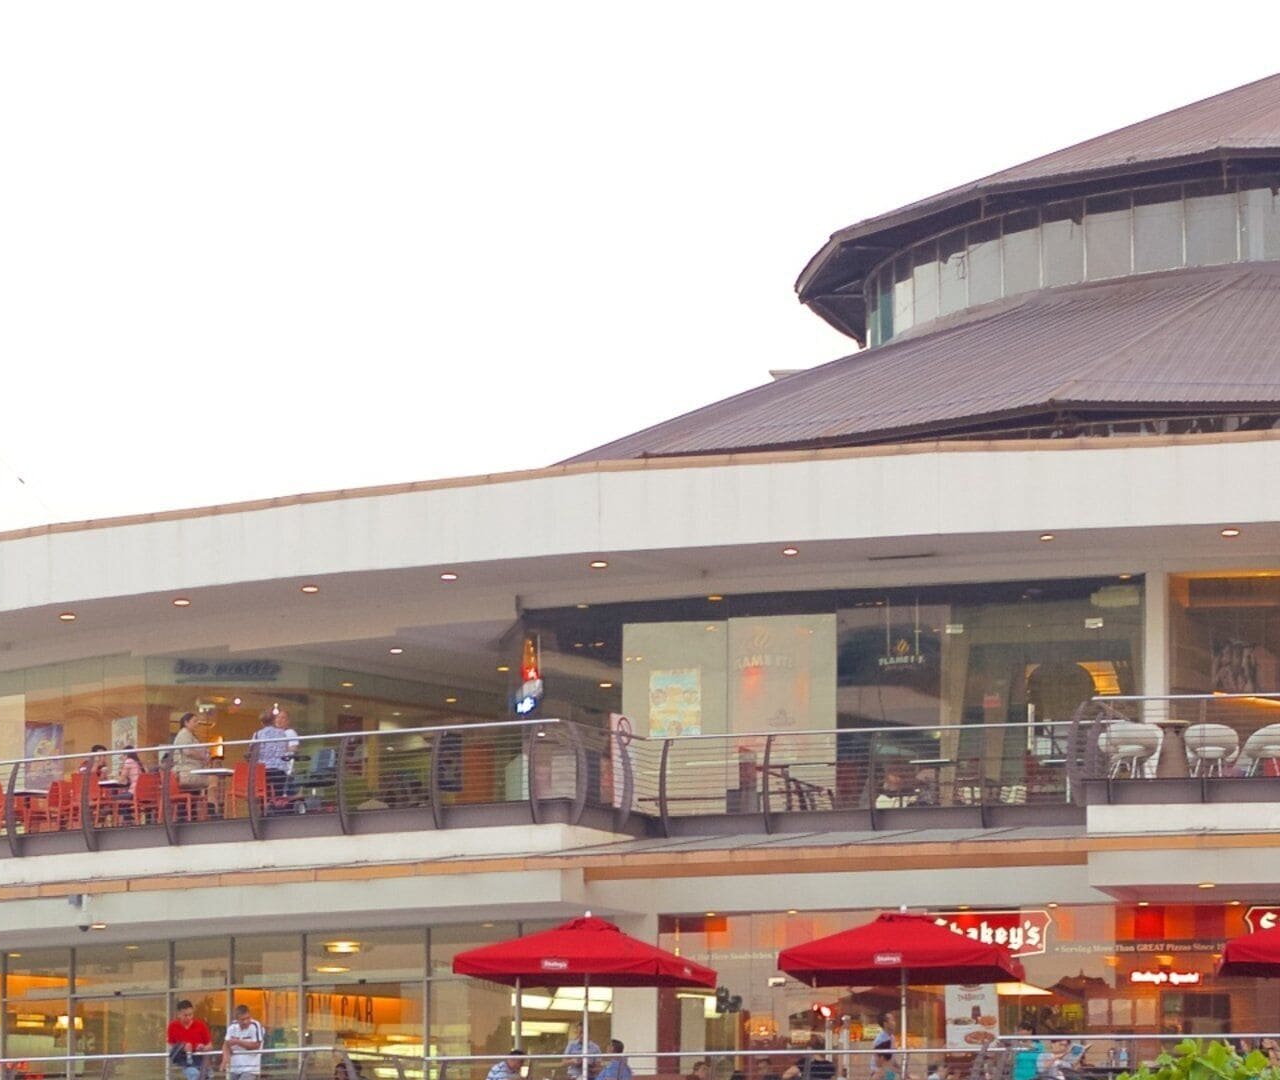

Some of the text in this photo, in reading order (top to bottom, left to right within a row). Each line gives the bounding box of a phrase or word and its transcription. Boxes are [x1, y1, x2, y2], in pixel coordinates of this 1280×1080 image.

[934, 917, 1041, 950] akey's
[1136, 943, 1164, 952] GREAT
[263, 990, 332, 1024] YELOW
